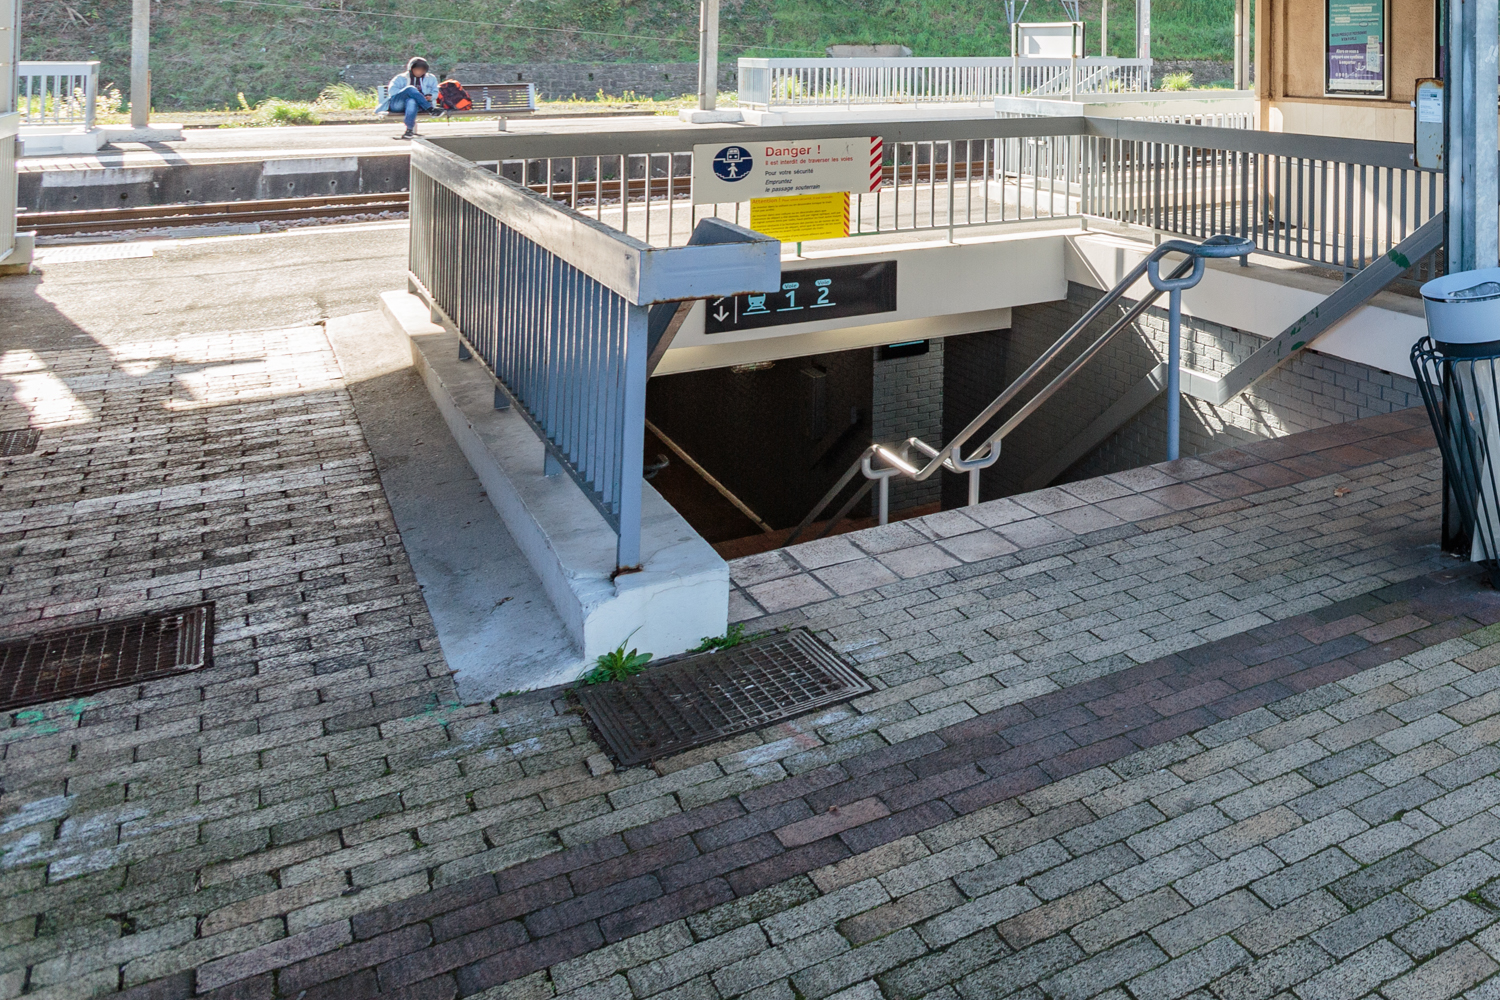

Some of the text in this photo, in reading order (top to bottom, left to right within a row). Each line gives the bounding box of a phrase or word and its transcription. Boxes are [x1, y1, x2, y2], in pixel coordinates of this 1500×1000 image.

[765, 145, 820, 158] Danger !
[786, 290, 795, 307] 1
[817, 287, 829, 304] 2
